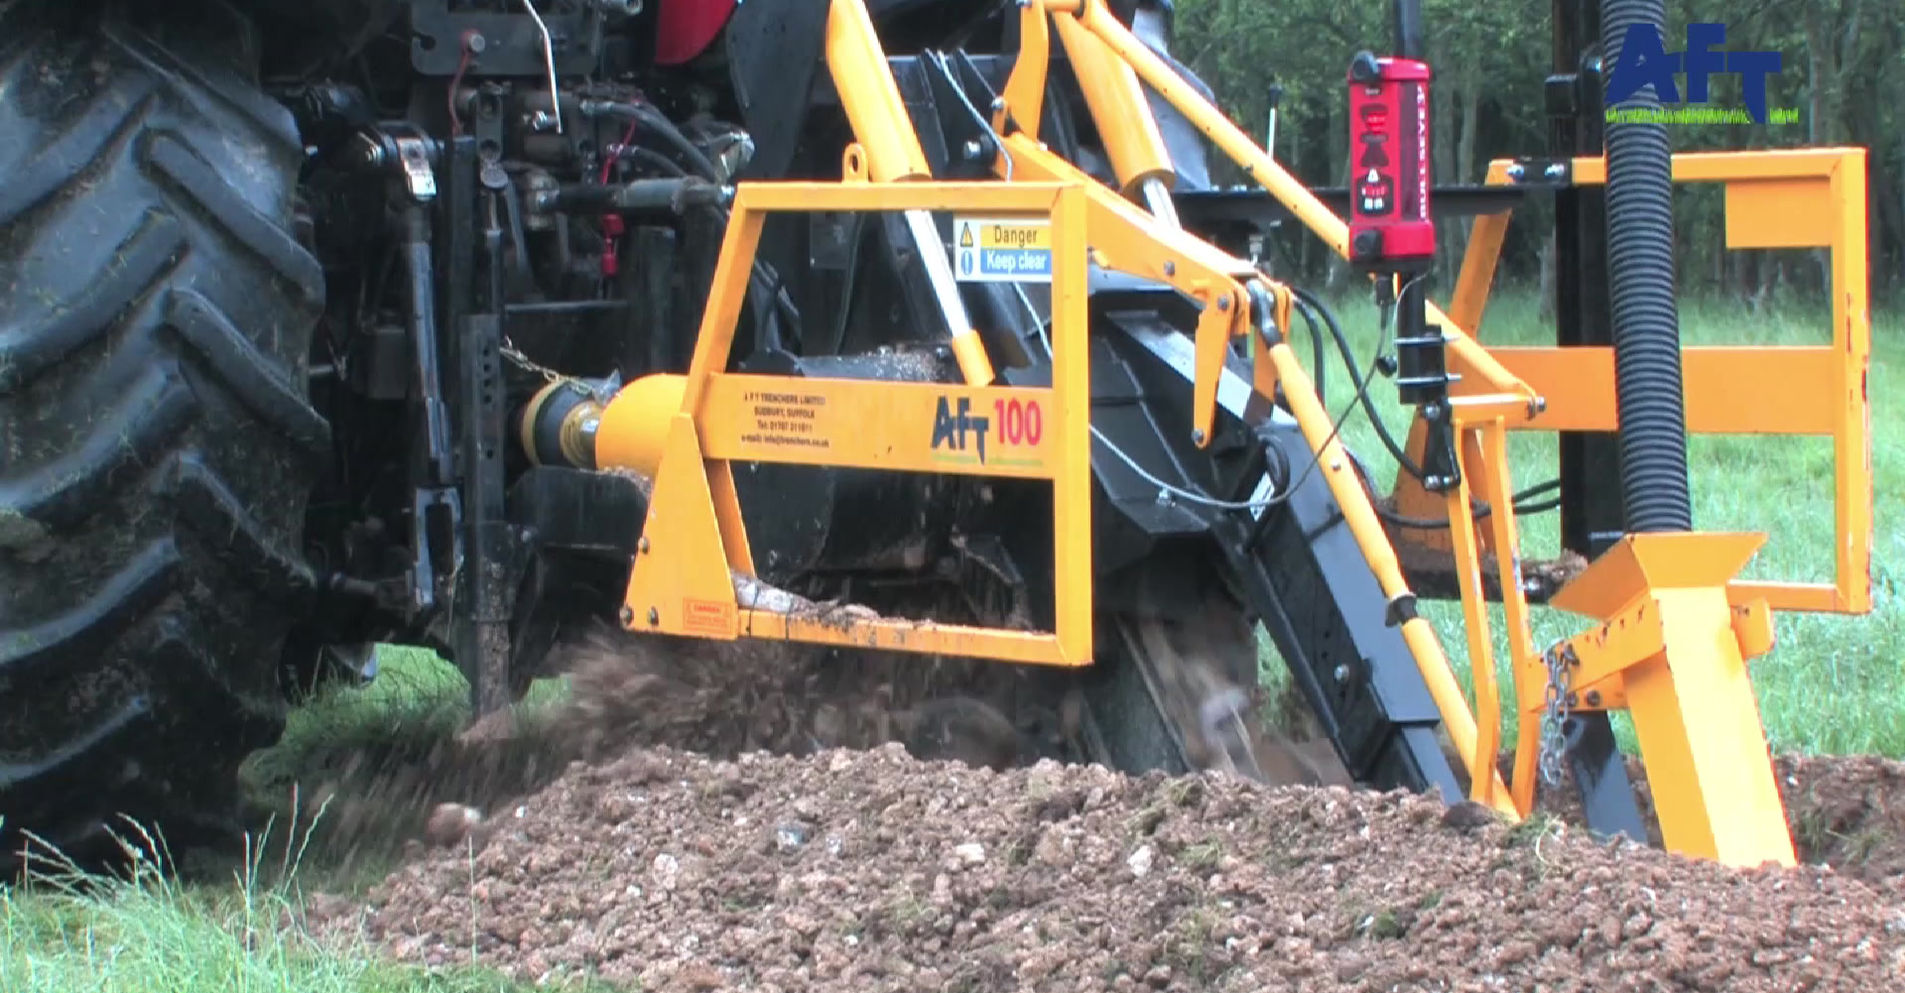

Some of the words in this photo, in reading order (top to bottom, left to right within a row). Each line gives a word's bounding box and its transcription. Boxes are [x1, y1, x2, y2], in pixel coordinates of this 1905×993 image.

[994, 225, 1038, 248] Danger
[986, 250, 1017, 274] Keep
[1018, 250, 1048, 271] clear
[761, 393, 799, 404] TRENCHERS
[800, 395, 827, 406] LIMITED
[786, 408, 816, 420] SUFFOLK
[930, 396, 989, 466] AFT
[994, 397, 1042, 446] 100
